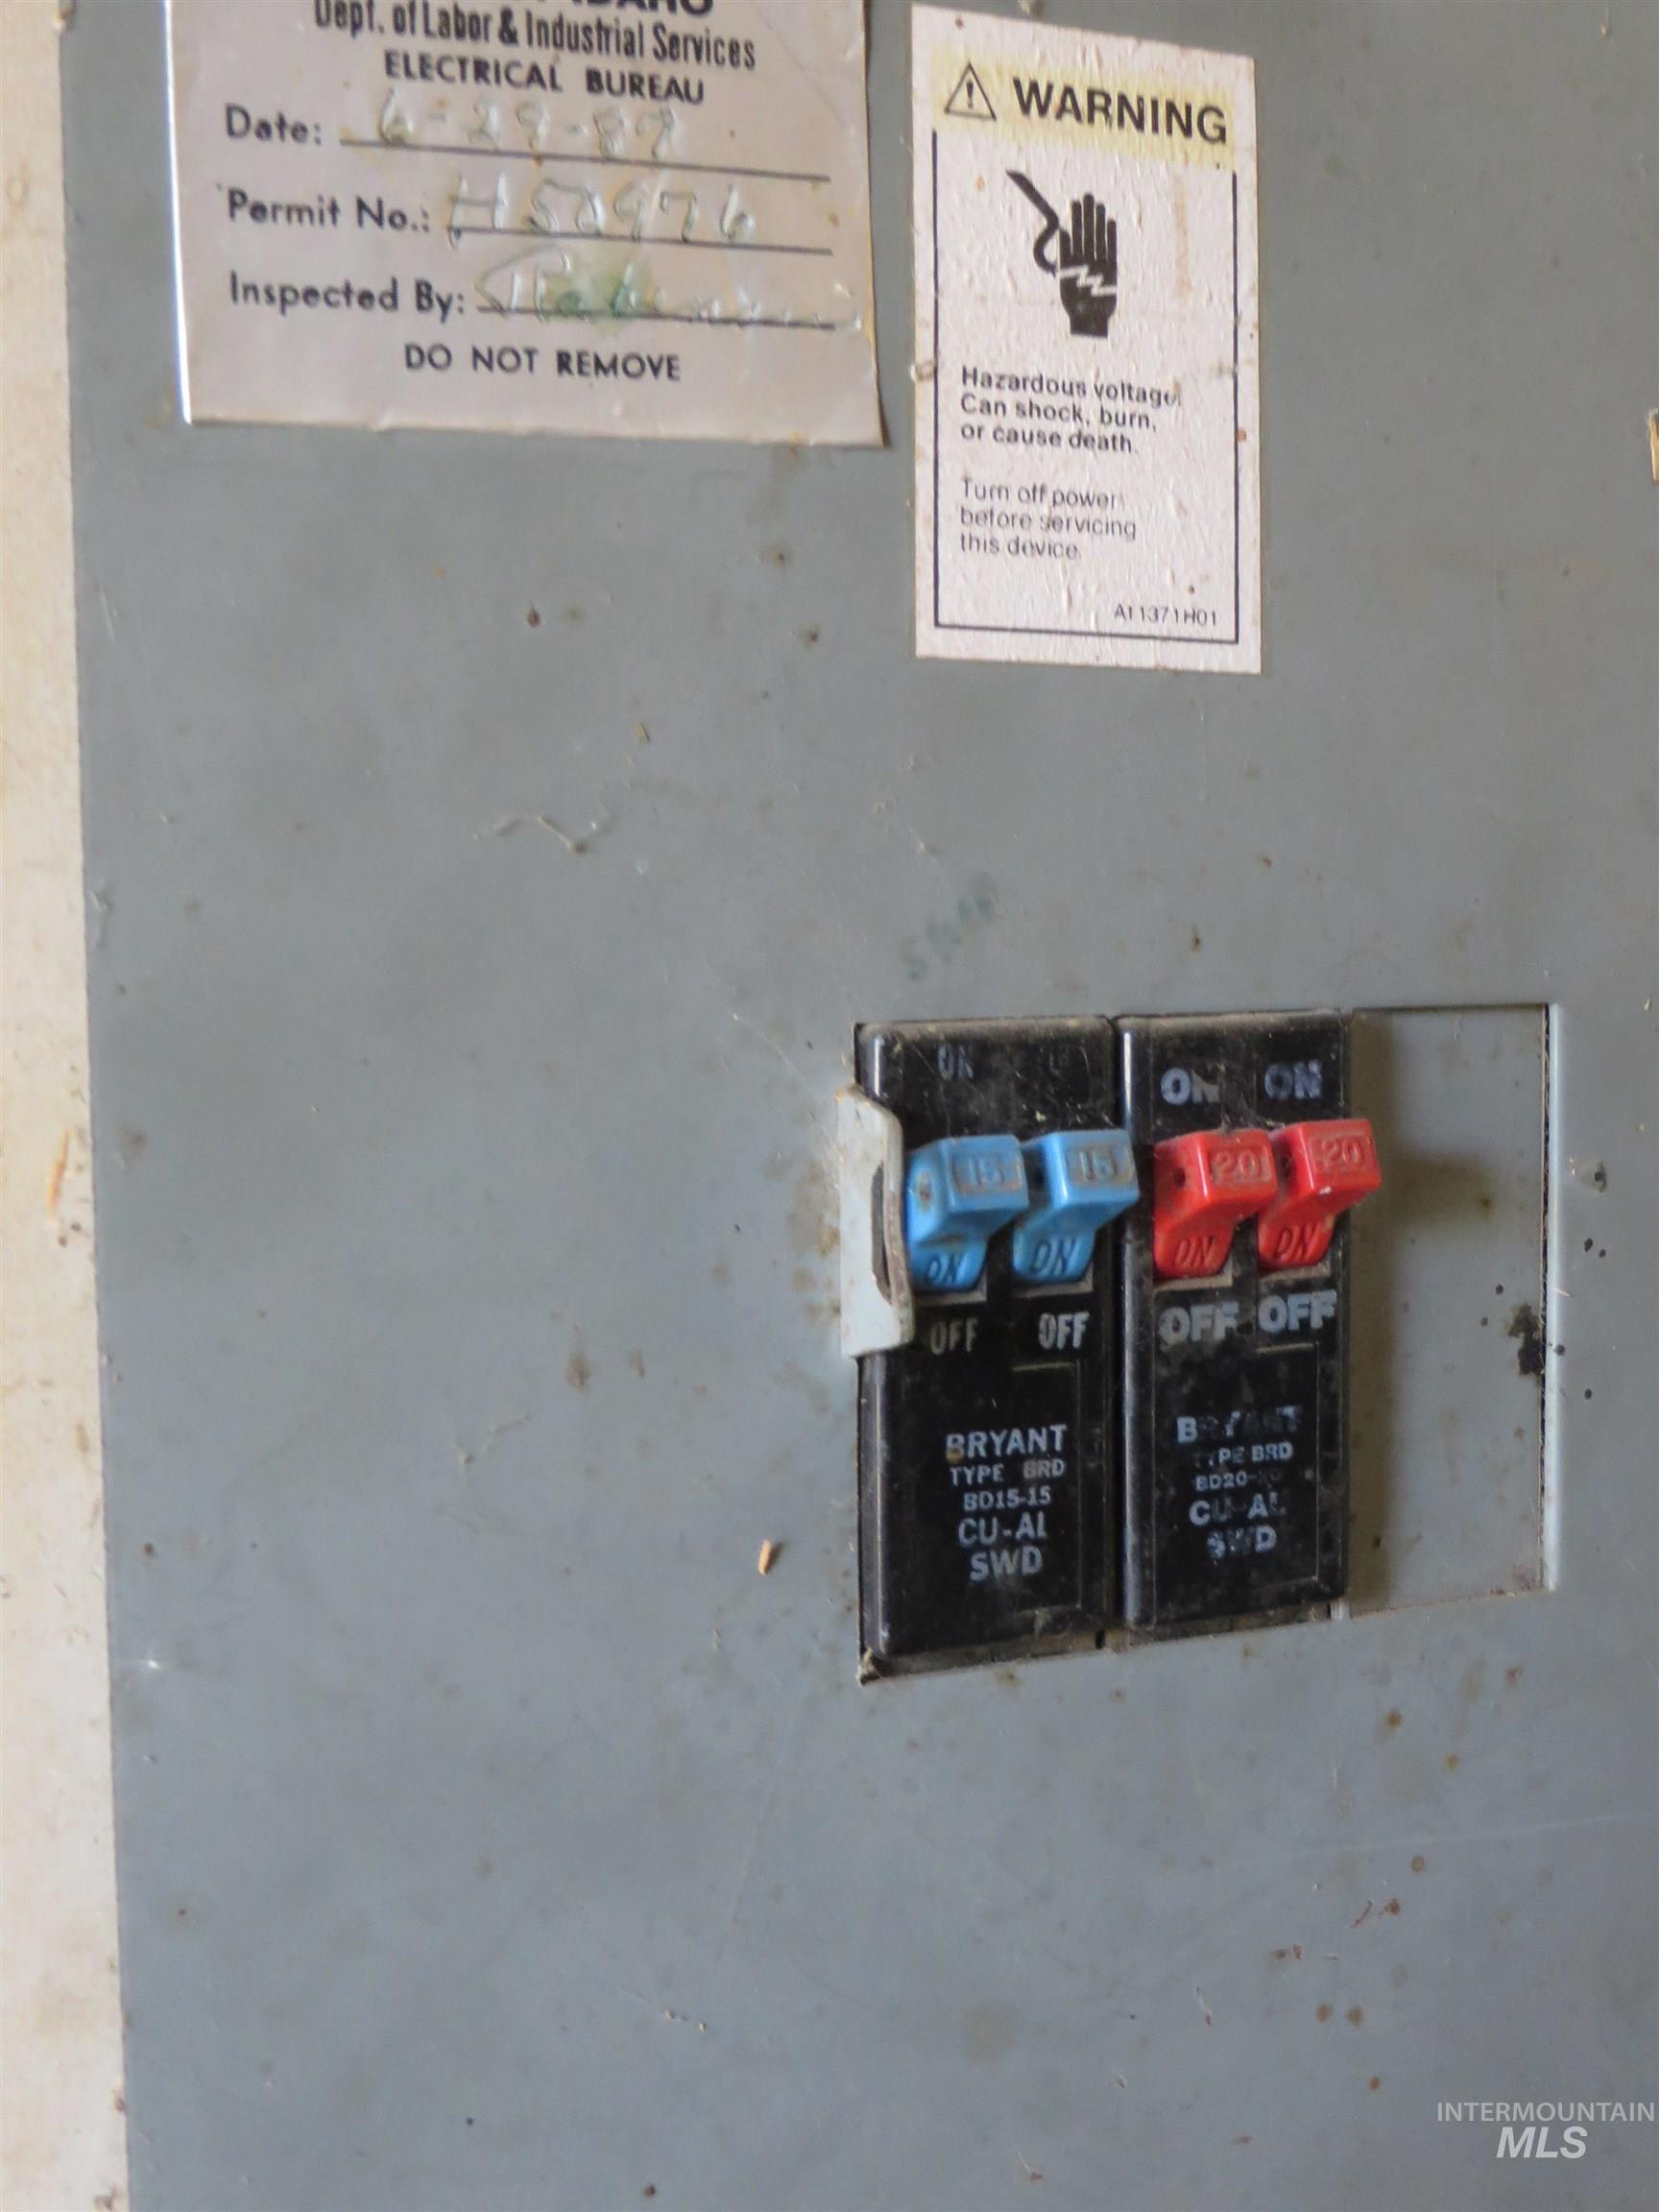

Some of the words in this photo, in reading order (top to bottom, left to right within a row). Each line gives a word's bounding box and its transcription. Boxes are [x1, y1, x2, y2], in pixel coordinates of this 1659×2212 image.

[315, 0, 384, 38] Dept.
[393, 0, 416, 36] of
[422, 0, 493, 43] Labor
[498, 7, 519, 46] &
[525, 9, 644, 58] Industrial
[653, 20, 757, 70] Services
[385, 49, 563, 92] ELECTRICAL
[586, 66, 705, 105] BUREAU
[226, 102, 322, 145] Date:
[1013, 76, 1227, 144] WARNING
[228, 186, 340, 231] Permit
[355, 195, 430, 232] No.:
[230, 269, 399, 317] Inspected
[415, 276, 466, 324] By:
[405, 342, 453, 372] DO
[471, 344, 539, 375] NOT
[556, 349, 681, 382] REMOVE
[961, 365, 1088, 398] Hazardous
[961, 392, 1008, 417] Can
[1015, 398, 1091, 427] shock,
[1099, 405, 1158, 432] burn,
[960, 422, 985, 441] or
[992, 425, 1063, 447] cause
[961, 477, 1011, 502] Turn
[1017, 482, 1048, 506] off
[1052, 486, 1116, 512] power
[960, 505, 1033, 531] before
[1039, 514, 1138, 541] servicing
[960, 532, 1001, 556] this
[1264, 1058, 1324, 1101] ON
[1211, 1151, 1262, 1185] 20
[1319, 1138, 1364, 1172] 20
[1031, 1238, 1077, 1277] ON
[1274, 1222, 1321, 1261] ON
[1038, 1310, 1091, 1350] OFF
[1158, 1301, 1238, 1344] OFF
[1258, 1289, 1337, 1334] OFF
[929, 1317, 978, 1356] OFF
[946, 1424, 1068, 1463] BRYANT
[1251, 1441, 1294, 1463] BRD
[950, 1462, 1005, 1487] TYPE
[970, 1546, 1043, 1582] SWD
